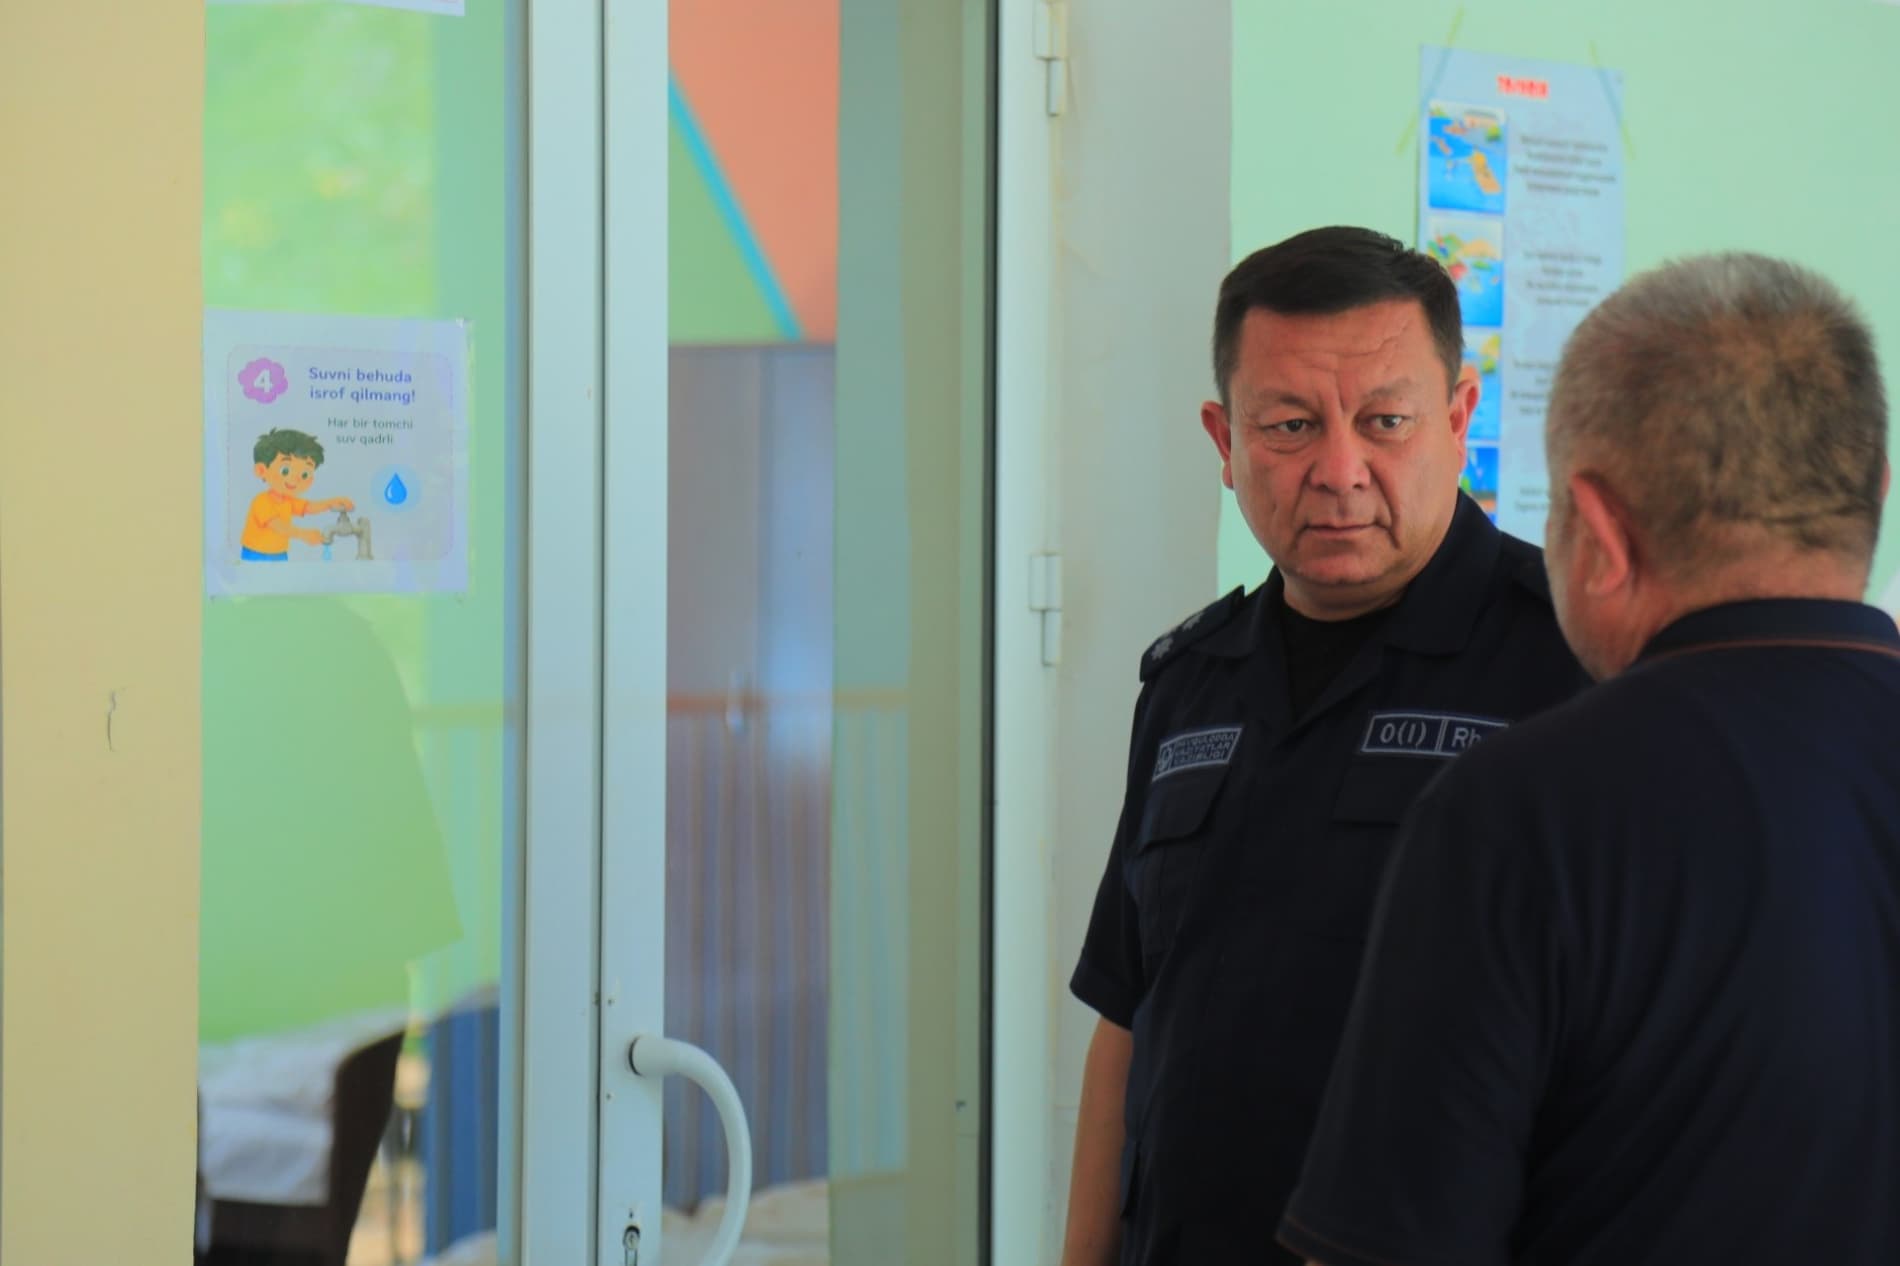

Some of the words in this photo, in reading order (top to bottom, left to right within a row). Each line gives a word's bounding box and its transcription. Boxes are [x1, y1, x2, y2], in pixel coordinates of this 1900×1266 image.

[254, 369, 273, 393] 4
[309, 367, 351, 381] Suvni
[357, 368, 412, 383] behuda
[310, 385, 345, 400] isrof
[351, 387, 416, 405] qilmang!
[327, 417, 348, 428] Har
[353, 418, 367, 428] bir
[373, 418, 413, 430] tomchi
[336, 435, 356, 444] suv
[360, 434, 393, 446] qadrli
